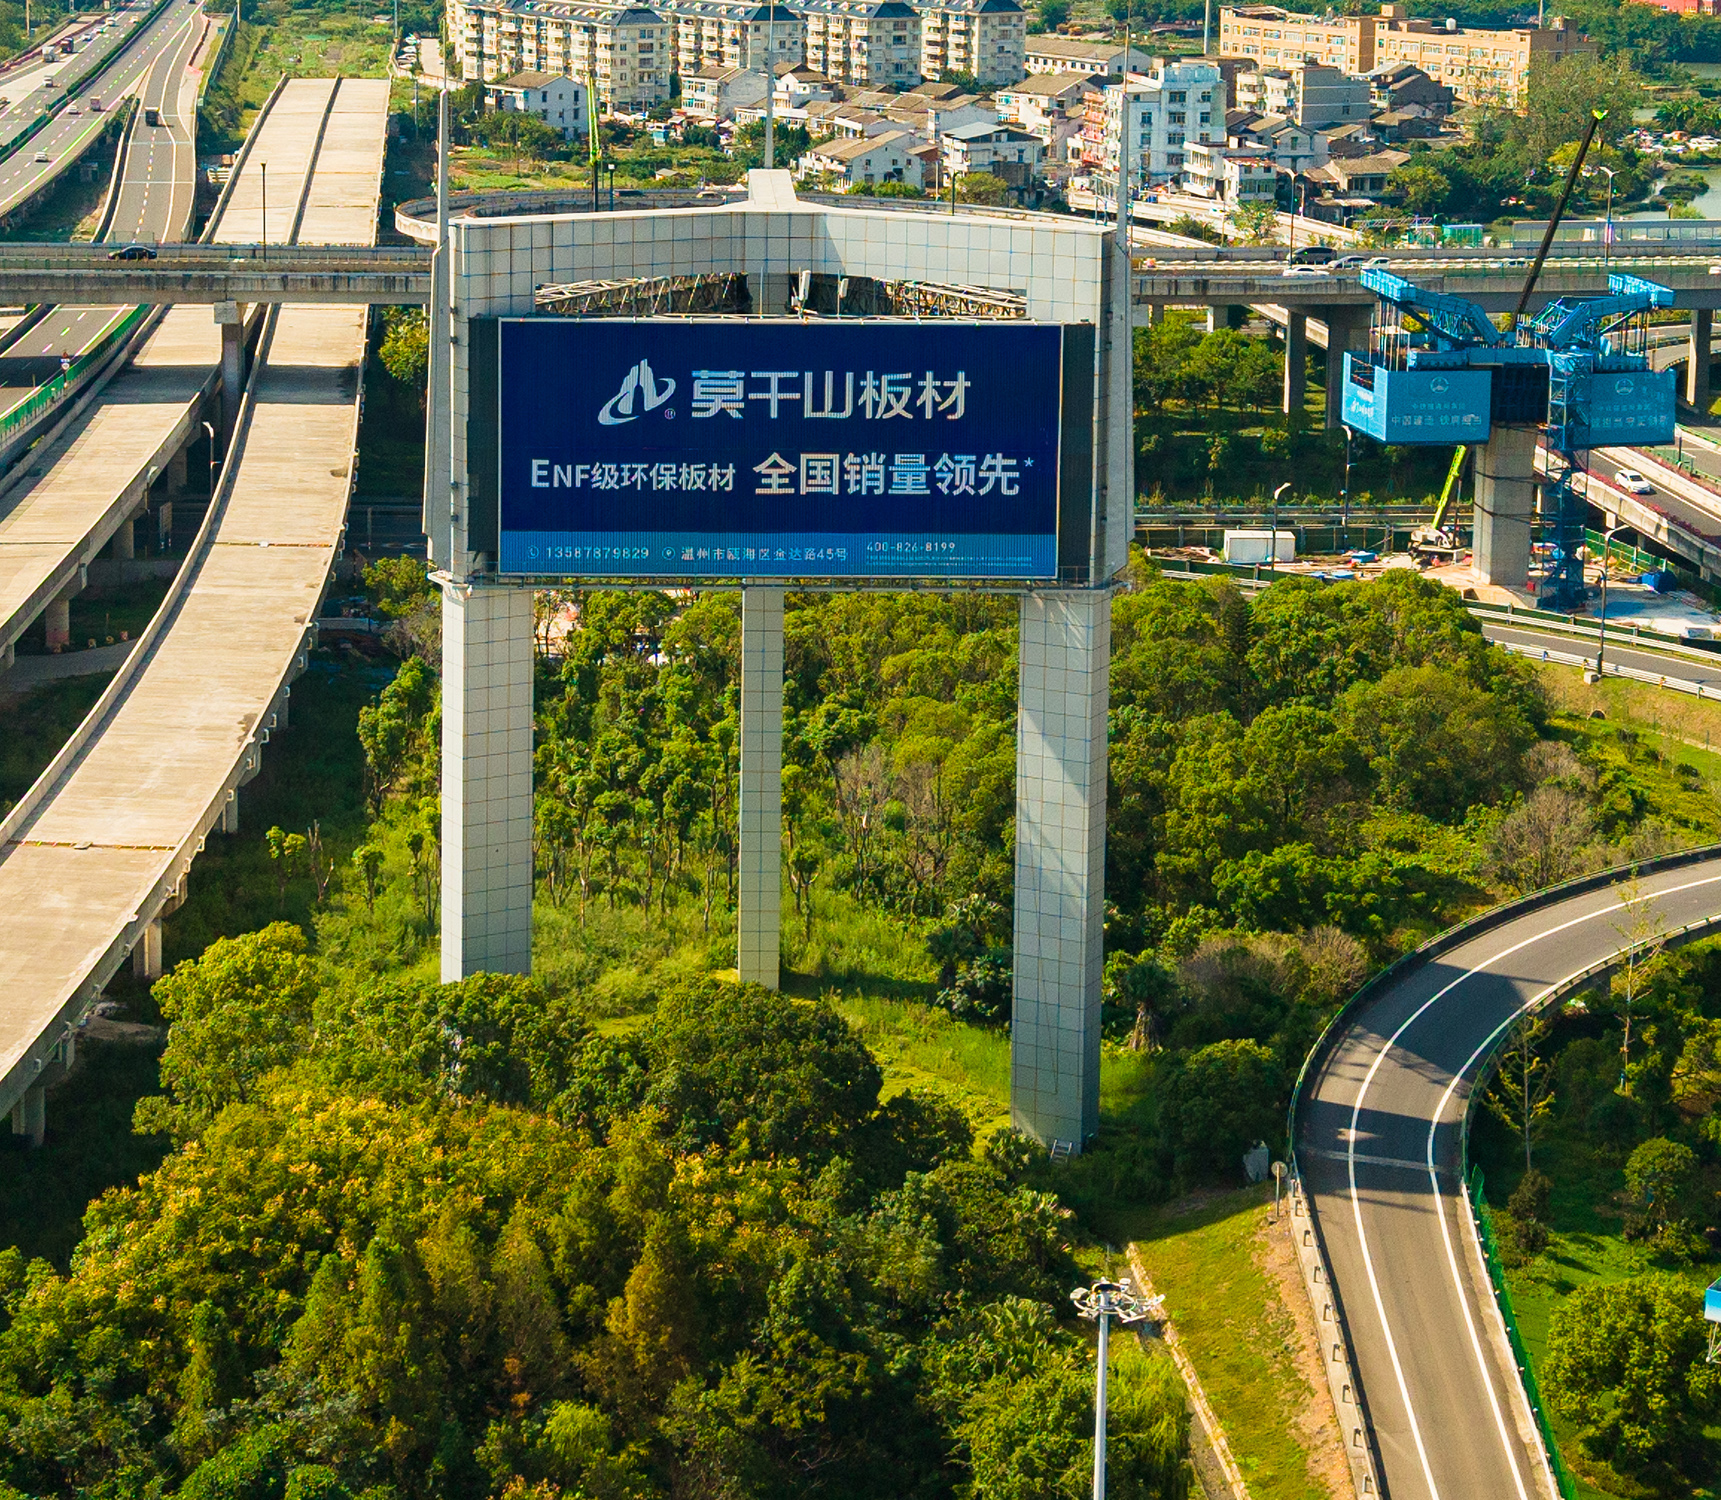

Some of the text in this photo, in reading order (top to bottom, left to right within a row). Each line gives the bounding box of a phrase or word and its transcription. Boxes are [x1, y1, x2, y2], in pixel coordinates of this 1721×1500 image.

[691, 369, 972, 420] 莫干山板材
[531, 458, 736, 492] ENF级环保板材
[546, 546, 650, 559] 13587879829
